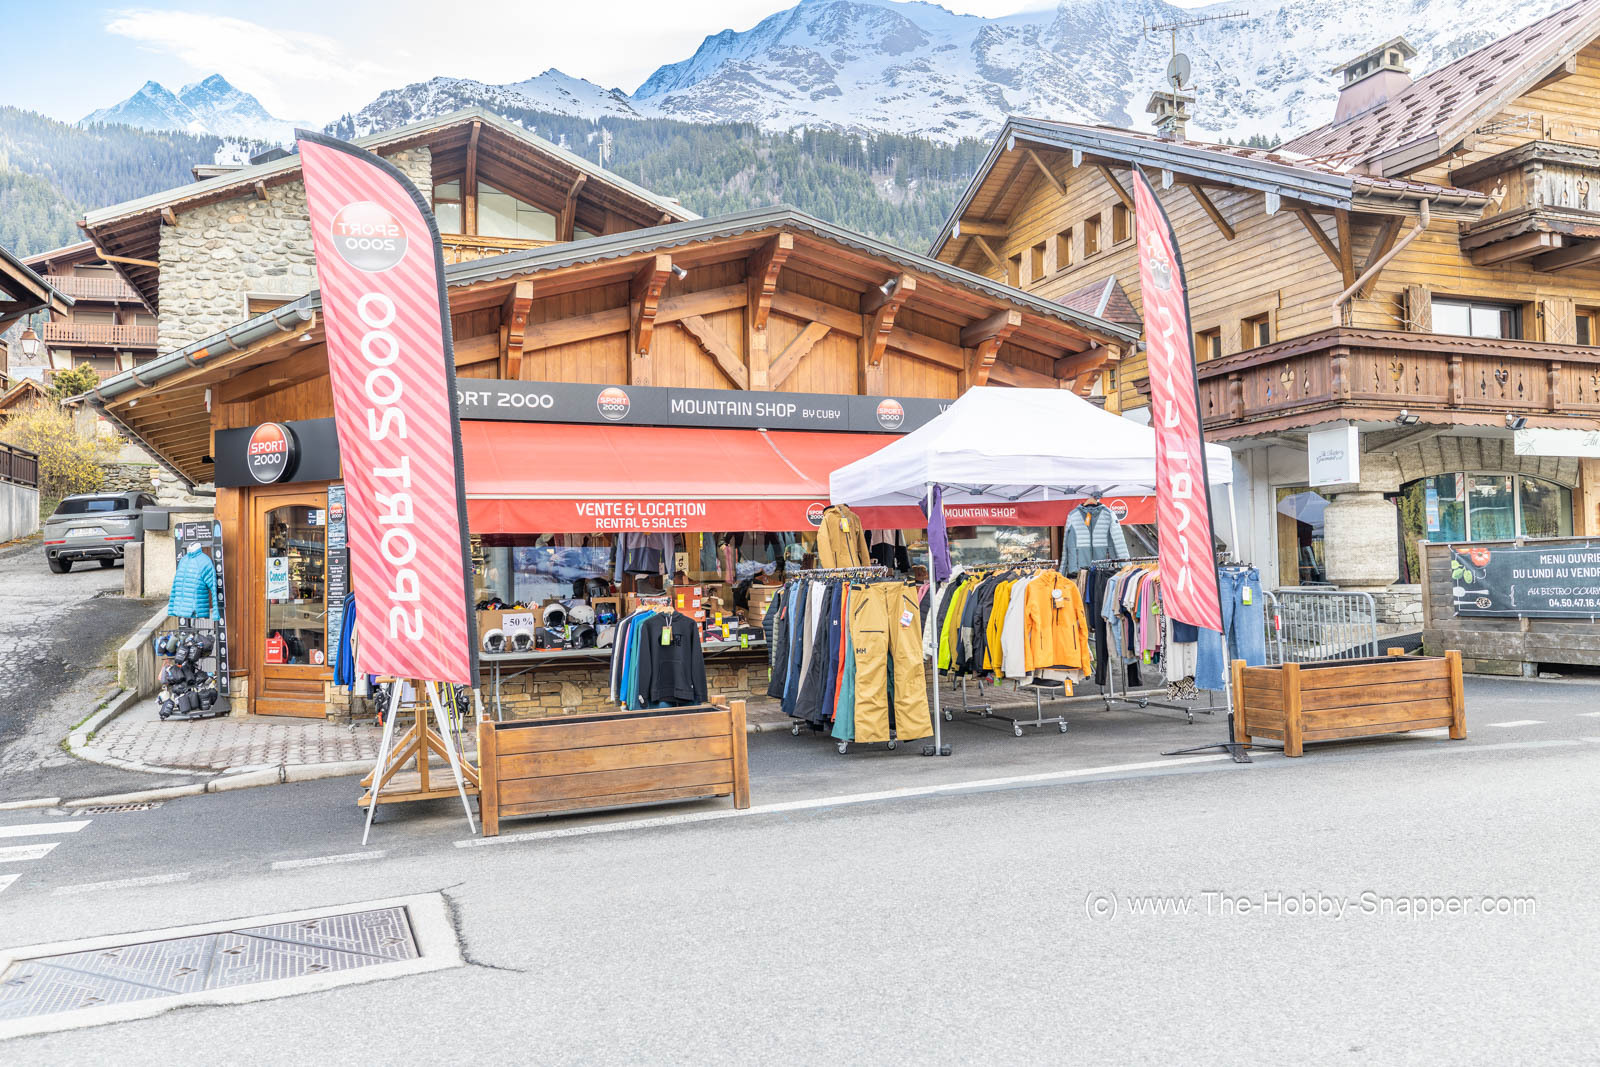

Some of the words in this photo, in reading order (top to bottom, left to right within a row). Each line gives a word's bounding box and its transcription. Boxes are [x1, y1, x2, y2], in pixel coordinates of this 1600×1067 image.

[497, 393, 554, 408] 2000
[600, 397, 627, 405] SPORT
[671, 399, 752, 416] MOUNTAIN
[756, 403, 797, 418] SHOP
[802, 409, 815, 418] BY
[816, 410, 841, 419] CUBY
[251, 440, 284, 454] SPORT
[254, 453, 281, 466] 2000
[576, 502, 622, 516] VENTE
[625, 502, 636, 516] &
[637, 502, 706, 516] LOCATION
[944, 508, 989, 517] MOUNTAIN
[991, 508, 1016, 518] SHOP
[596, 518, 641, 528] RENTAL
[642, 518, 650, 528] &
[652, 518, 688, 528] SALES
[1540, 554, 1566, 565] MENU
[1513, 569, 1525, 579] DU
[1527, 568, 1554, 578] LUNDI
[1556, 567, 1569, 578] AU
[1528, 587, 1540, 596] AU
[1541, 587, 1571, 596] BISTRO
[1572, 586, 1600, 596] GOUR
[509, 618, 520, 627] 50
